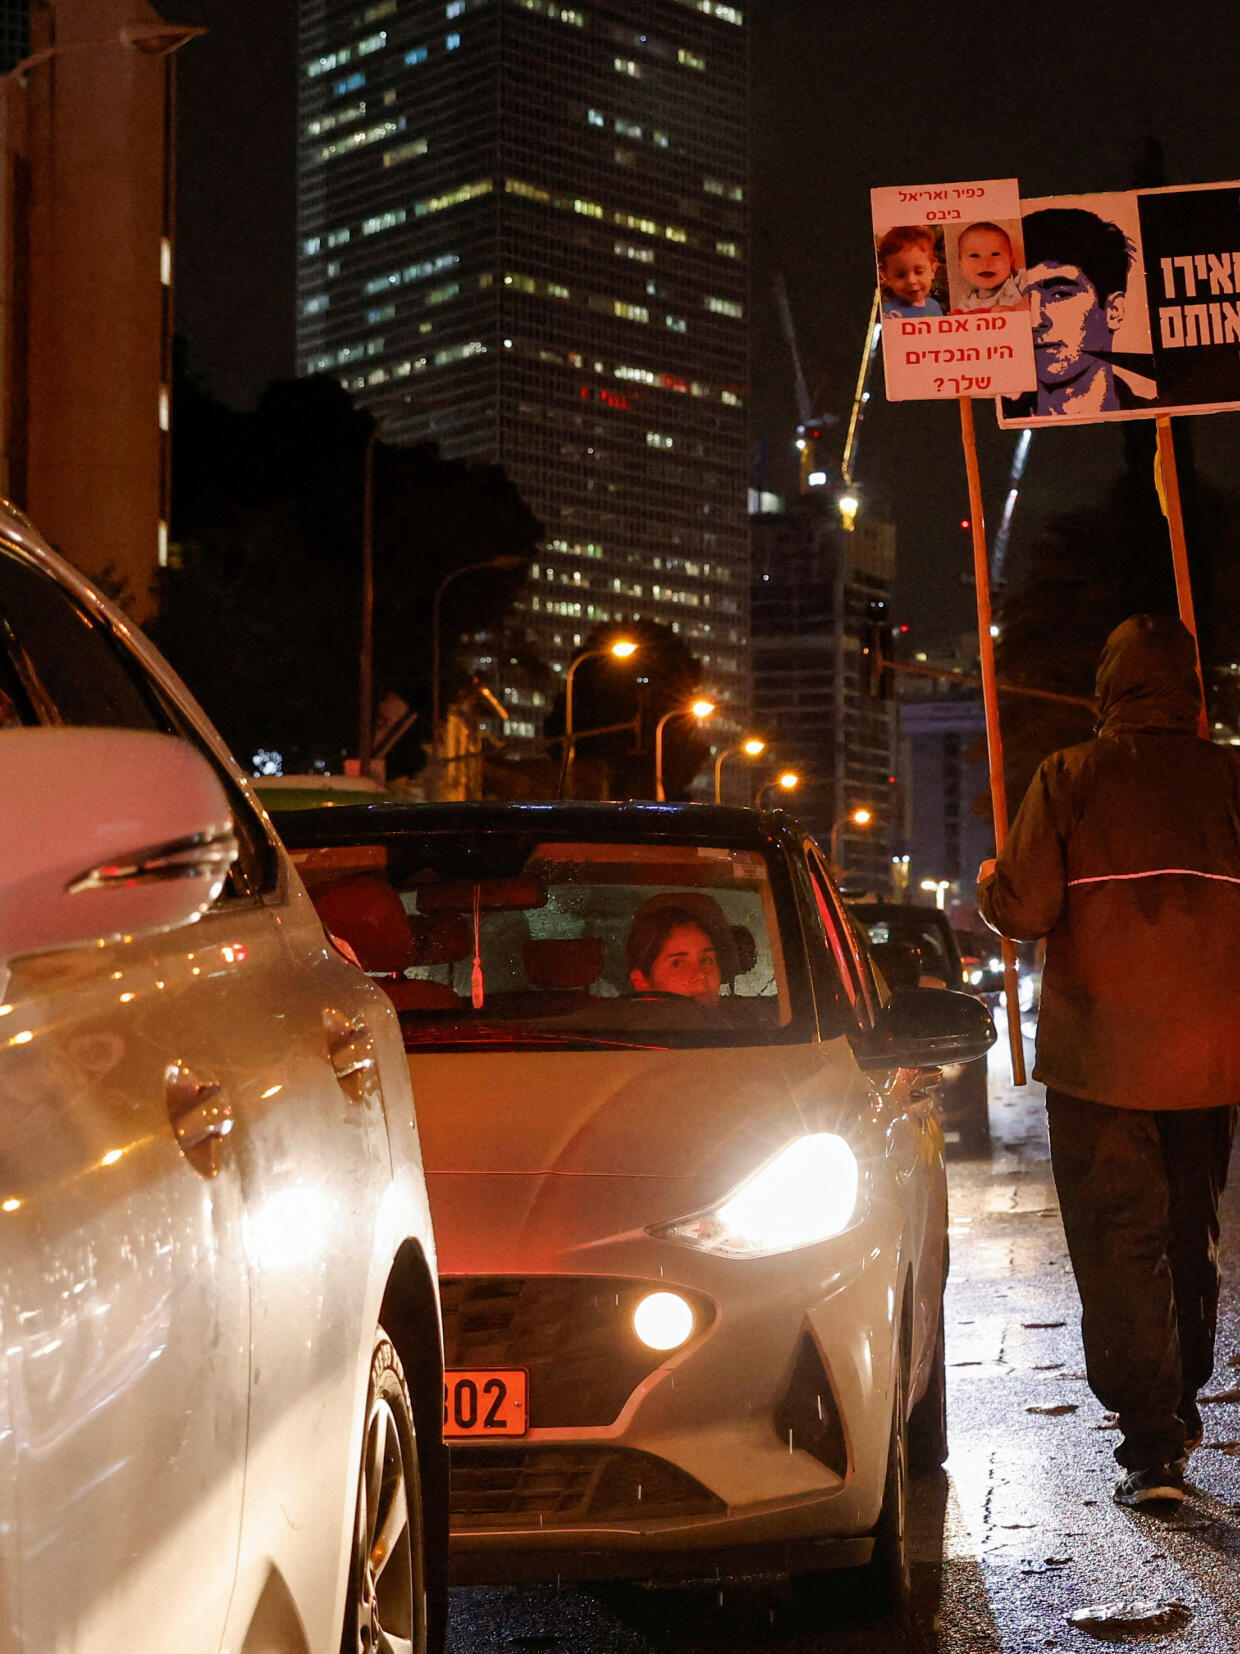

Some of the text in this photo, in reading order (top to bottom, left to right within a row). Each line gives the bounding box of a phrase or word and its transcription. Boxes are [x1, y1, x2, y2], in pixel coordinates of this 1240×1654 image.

[898, 187, 985, 202] כפיר ואריאל
[926, 209, 961, 221] ביבס
[901, 316, 1007, 336] מה אם הם
[905, 345, 1014, 365] היו הנכדים
[933, 374, 992, 394] שלך?
[443, 1378, 508, 1429] 02
